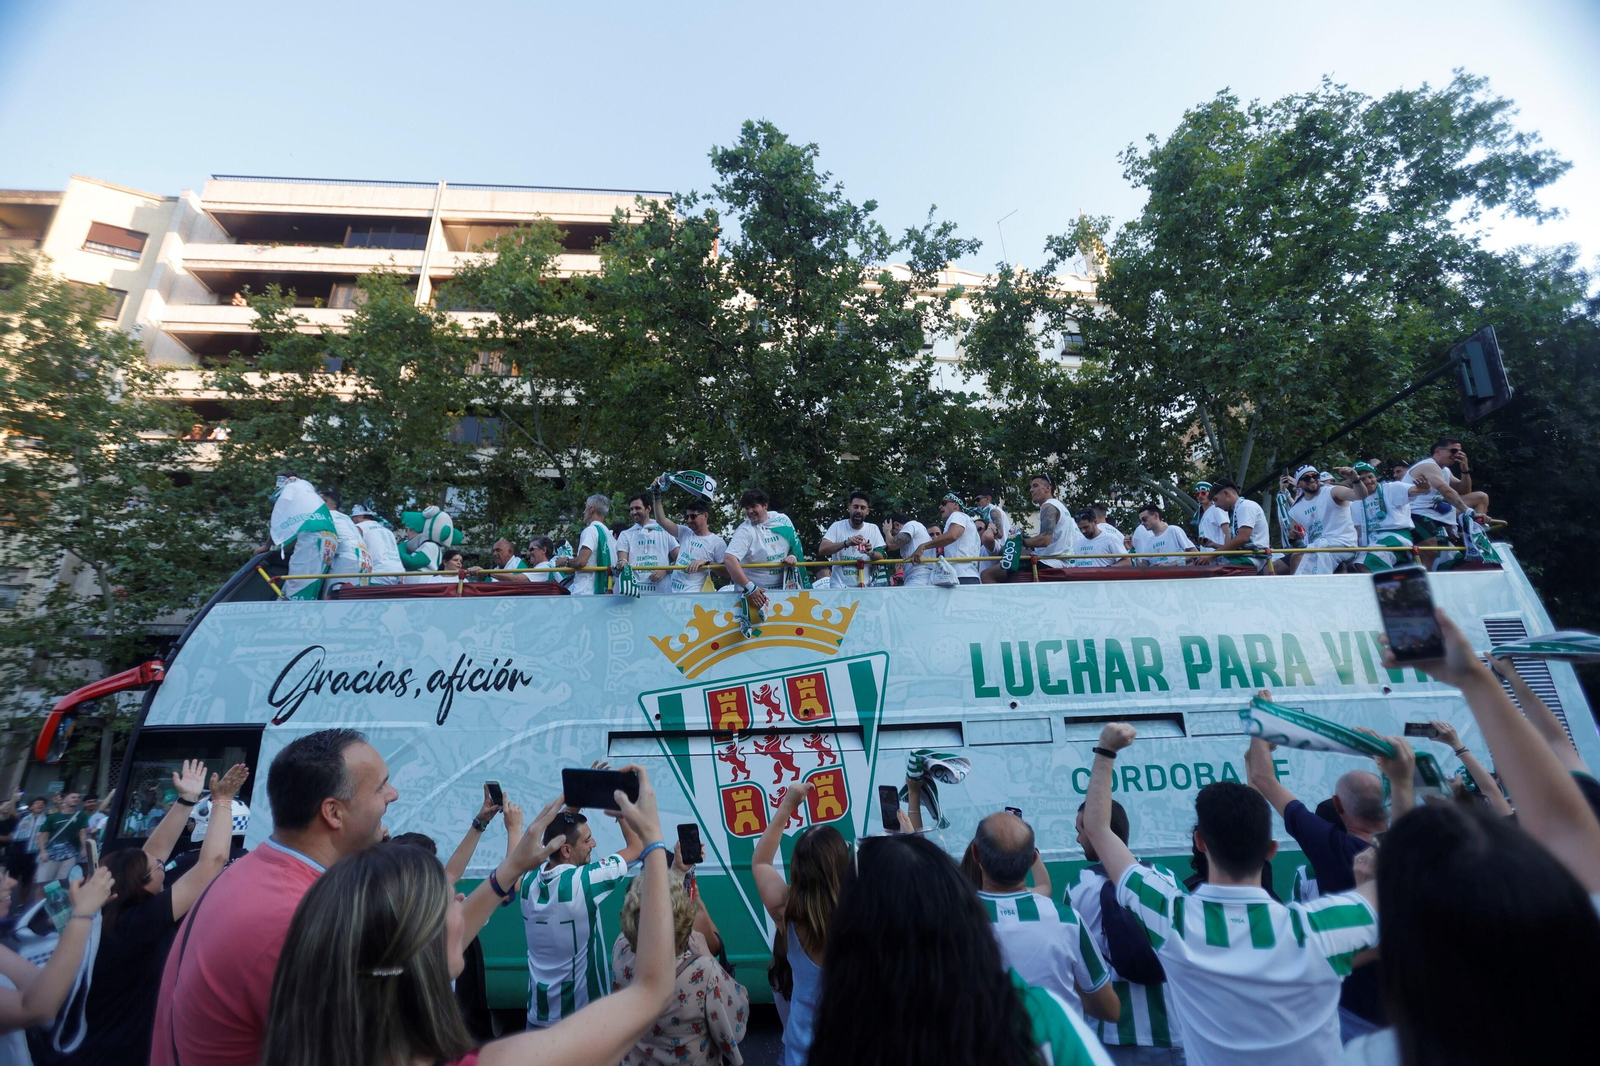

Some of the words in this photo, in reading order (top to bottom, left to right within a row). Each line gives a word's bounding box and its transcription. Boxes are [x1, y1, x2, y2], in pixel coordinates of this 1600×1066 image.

[969, 636, 1170, 699] LUCHAR
[1179, 633, 1316, 690] PARA
[1320, 630, 1440, 686] VIV
[267, 645, 421, 726] Gracias,
[426, 653, 533, 726] afición
[1000, 908, 1016, 917] 1954
[1230, 917, 1246, 925] 1954
